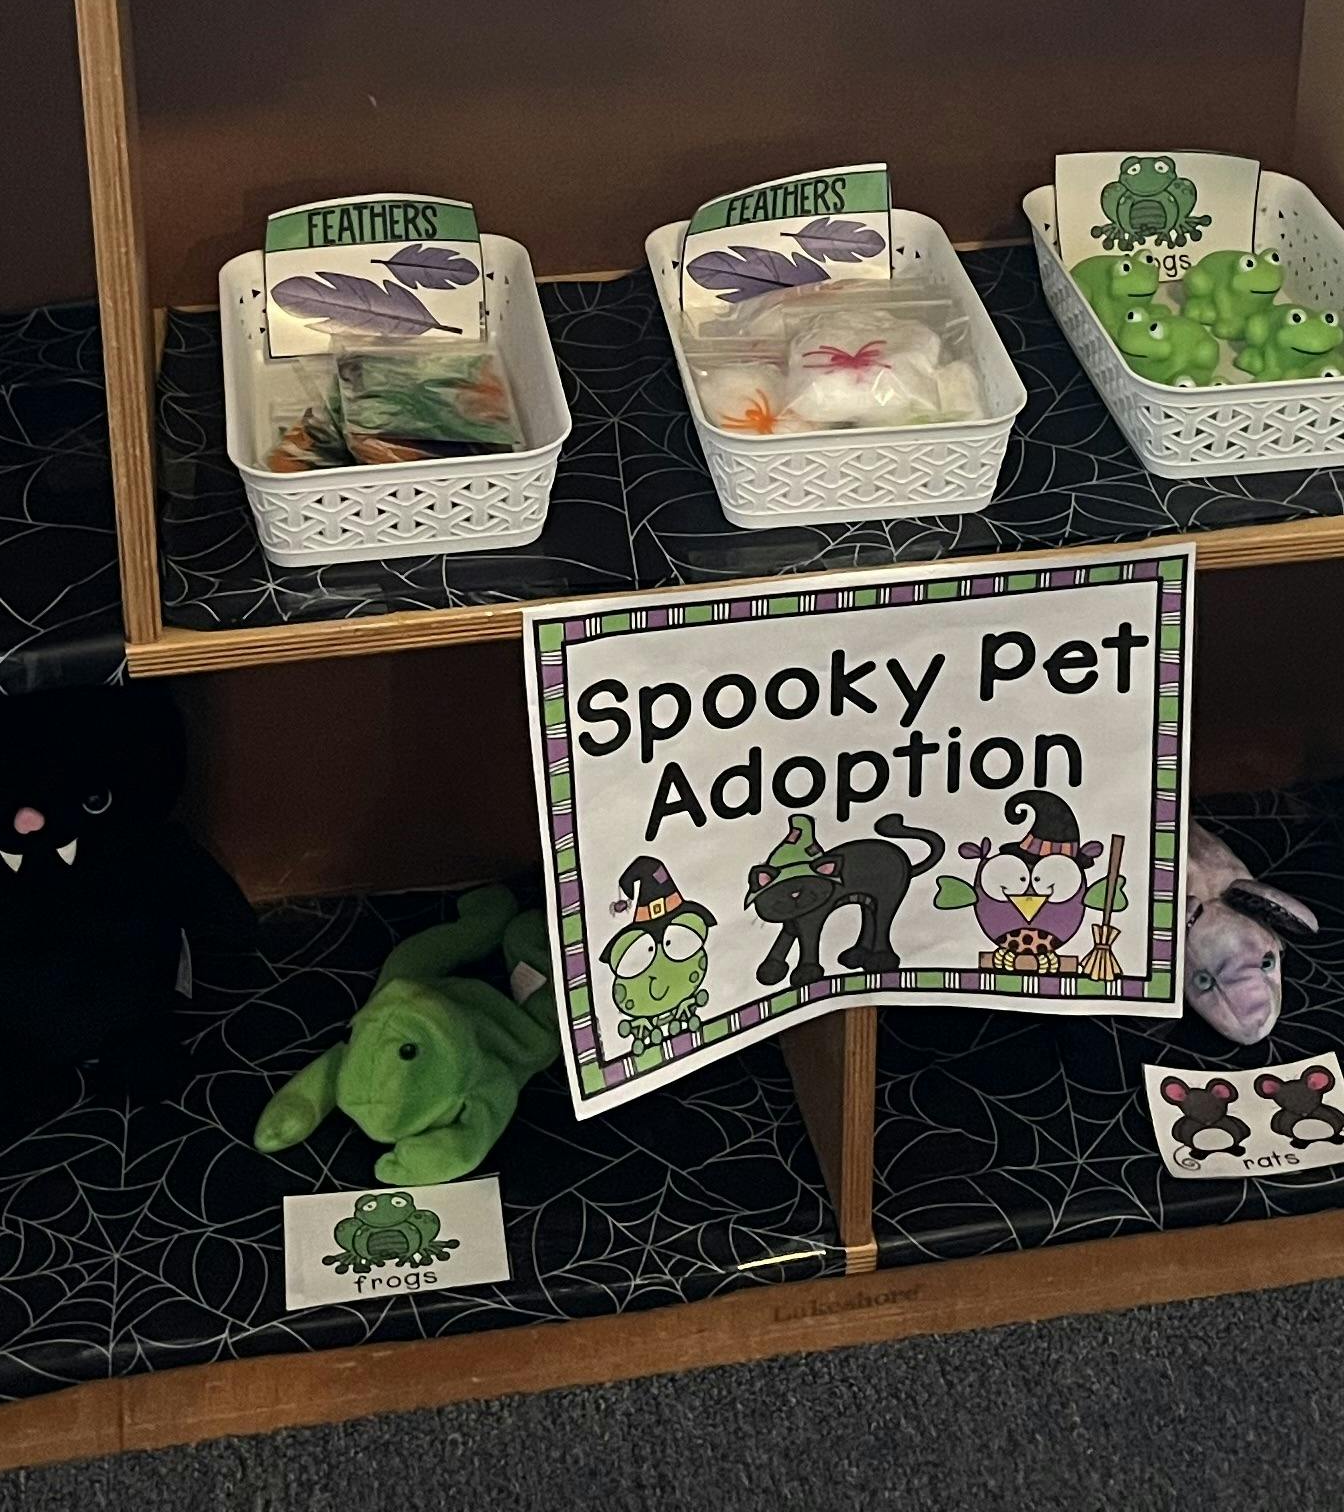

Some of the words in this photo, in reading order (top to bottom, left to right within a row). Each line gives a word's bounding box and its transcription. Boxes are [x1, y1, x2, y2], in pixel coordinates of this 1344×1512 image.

[307, 202, 439, 247] FEATHERS
[725, 176, 846, 228] FEATHERS
[577, 649, 947, 764] Spooky
[979, 621, 1150, 702] Pet
[644, 727, 1084, 842] Adoption
[1242, 1150, 1301, 1171] rats
[353, 1270, 438, 1294] frogs
